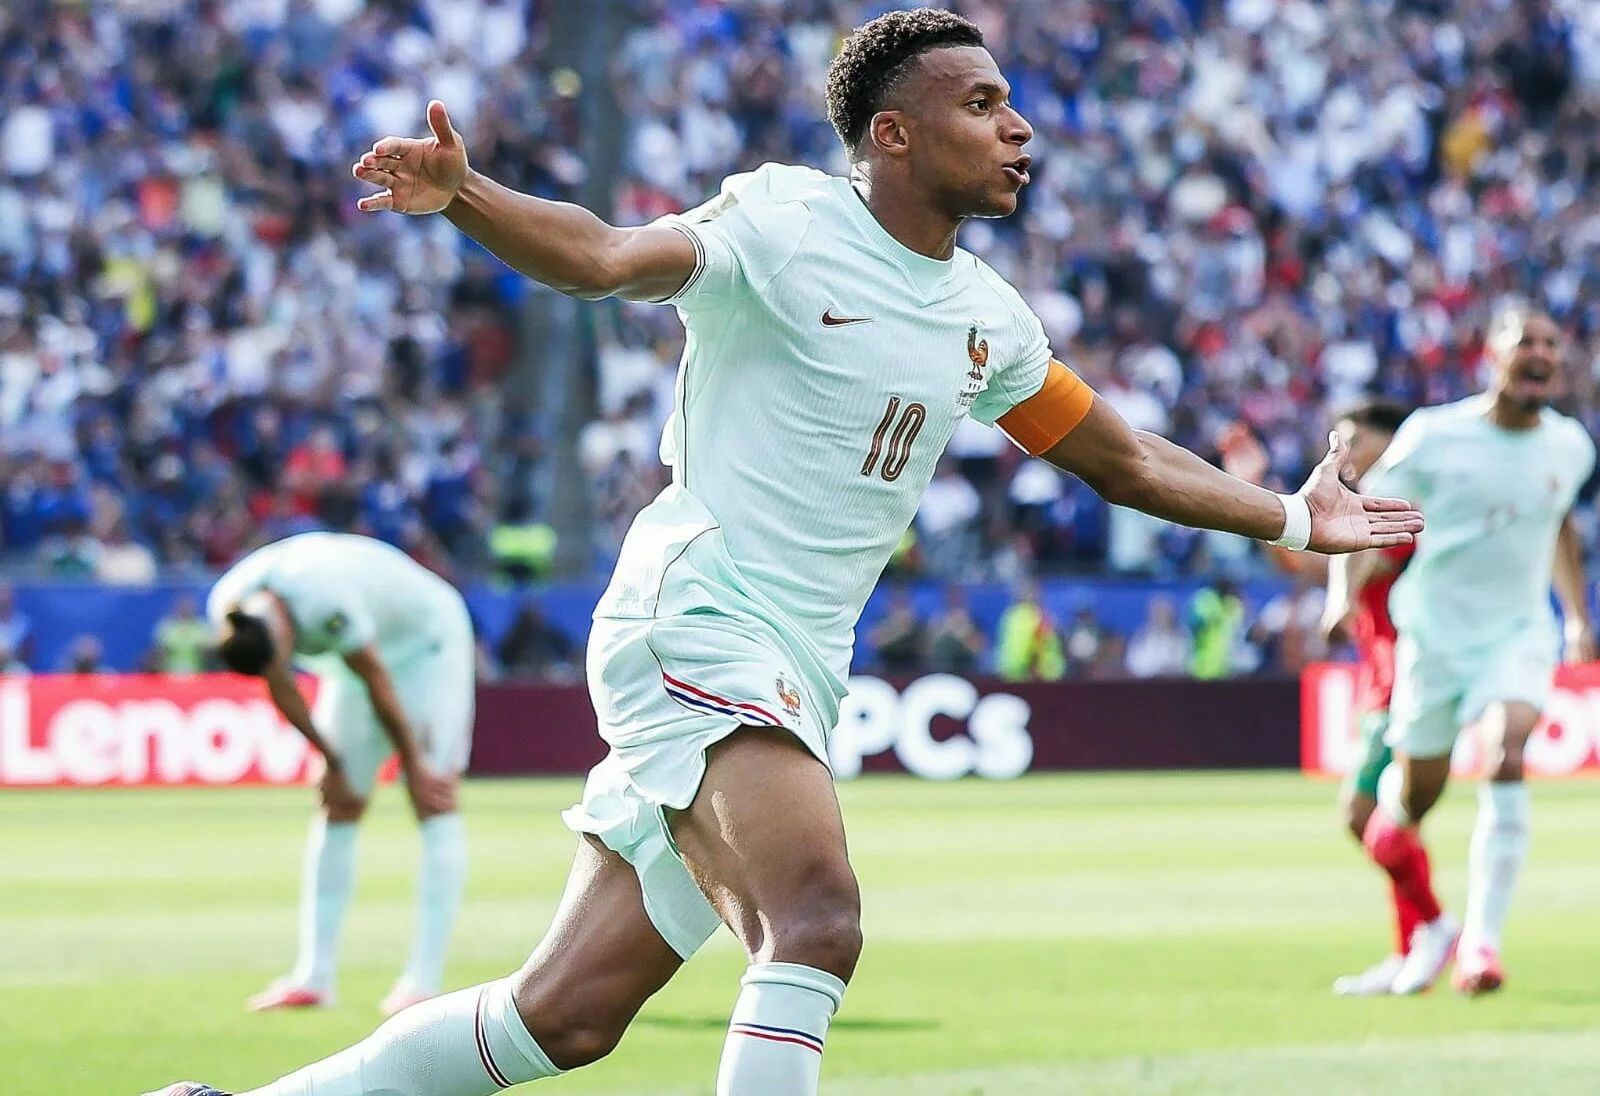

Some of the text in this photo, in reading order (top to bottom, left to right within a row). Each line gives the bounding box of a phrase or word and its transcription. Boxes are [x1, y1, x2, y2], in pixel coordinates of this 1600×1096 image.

[860, 396, 927, 482] 10
[0, 678, 323, 784] Lenov
[827, 674, 1034, 780] PCs
